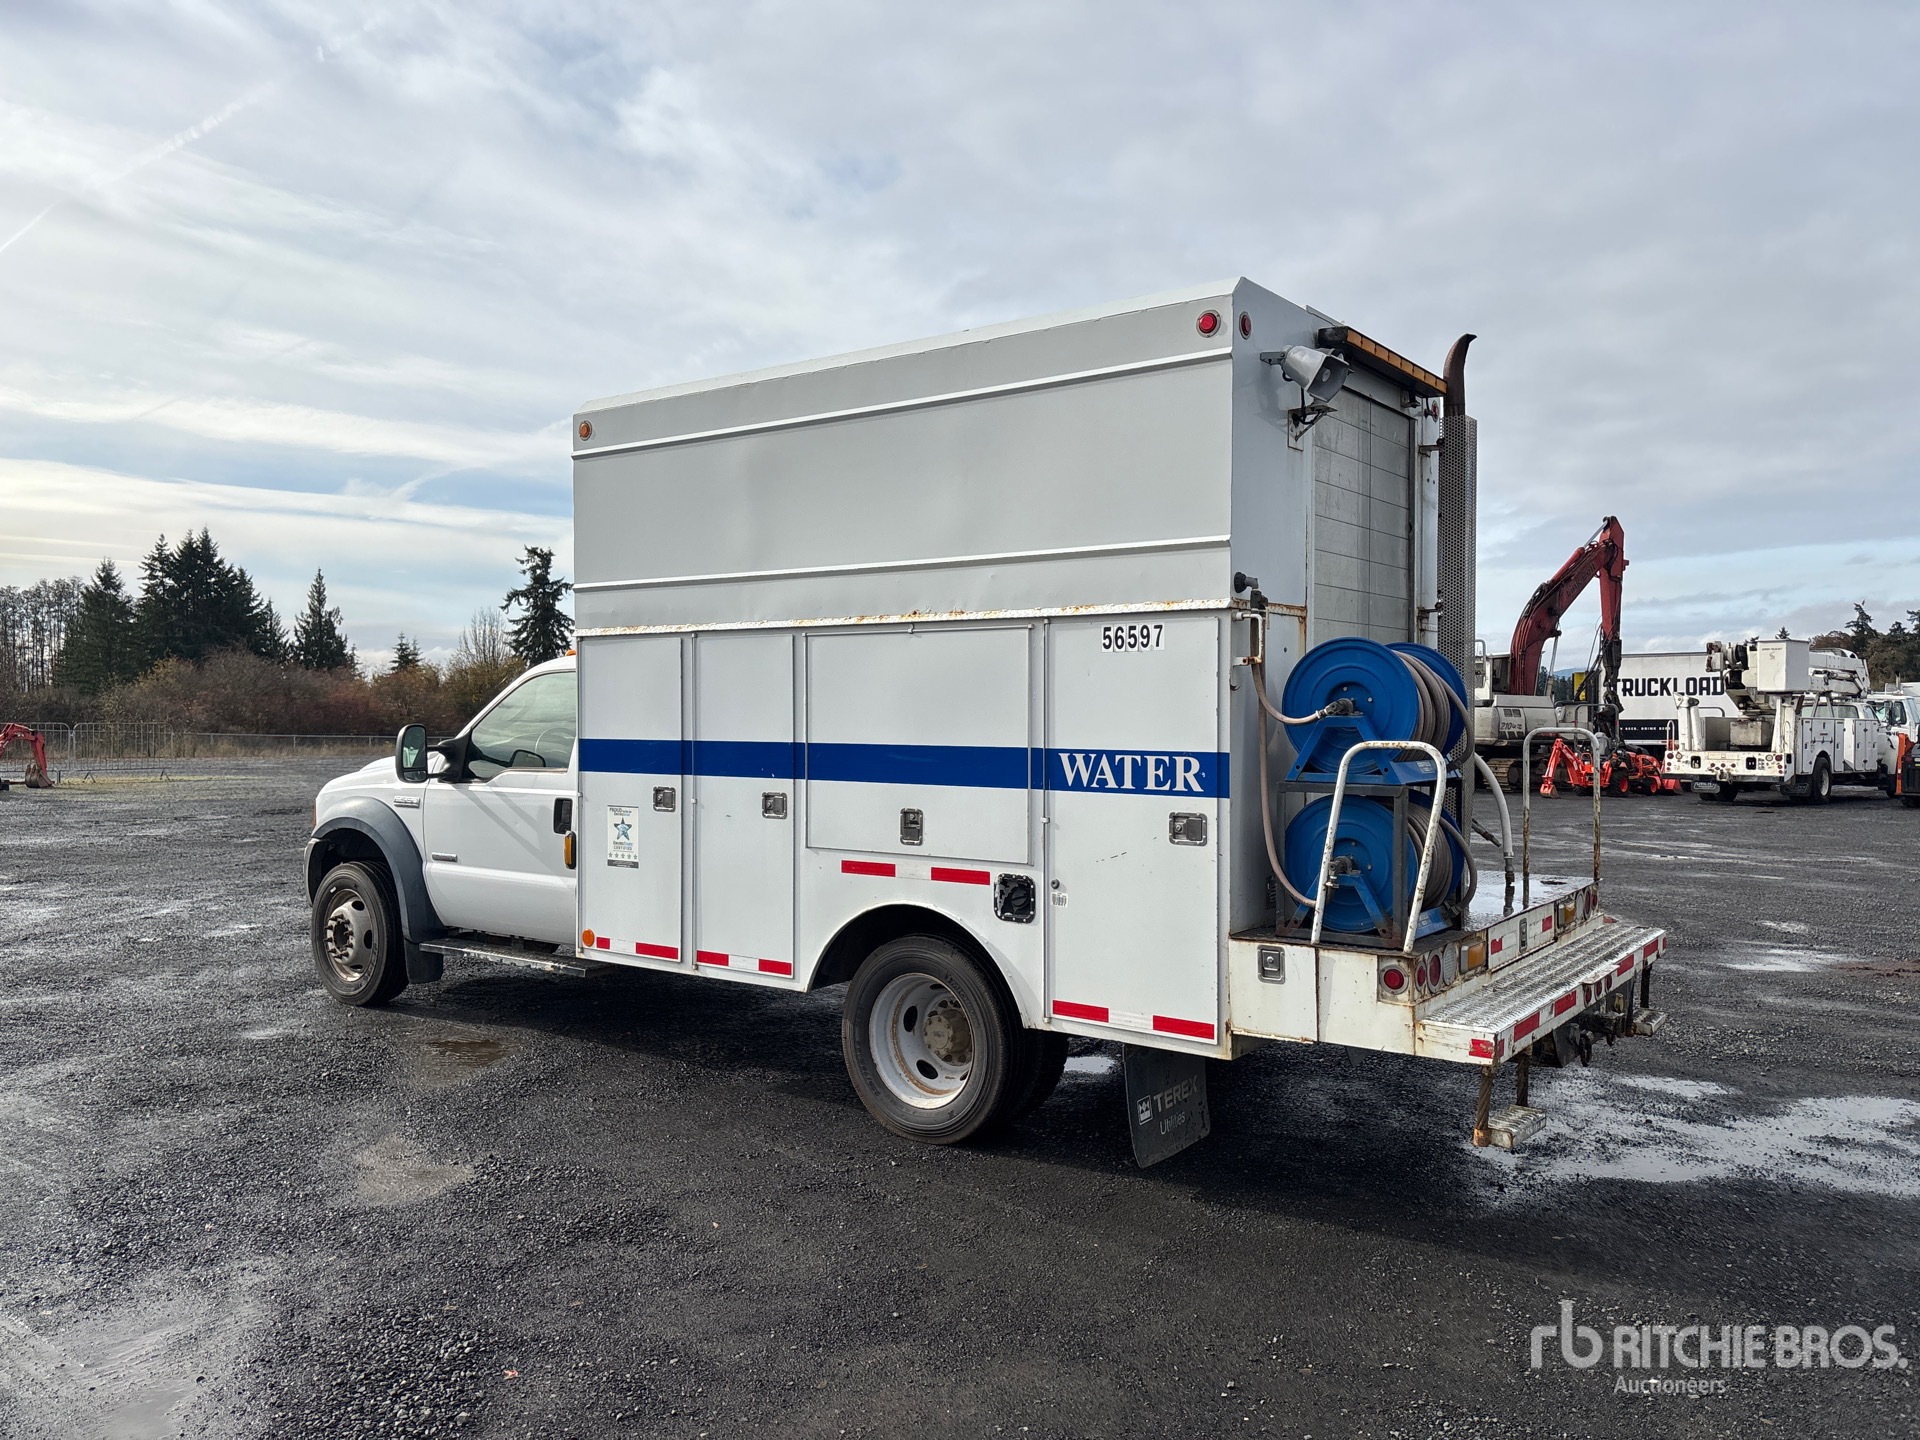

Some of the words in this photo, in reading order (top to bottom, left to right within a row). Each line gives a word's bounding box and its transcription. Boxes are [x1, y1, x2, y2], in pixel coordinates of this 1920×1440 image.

[1102, 625, 1163, 650] 56597
[1058, 752, 1204, 792] WATER
[1153, 1074, 1199, 1113] TEREX
[1159, 1111, 1186, 1135] Utilities
